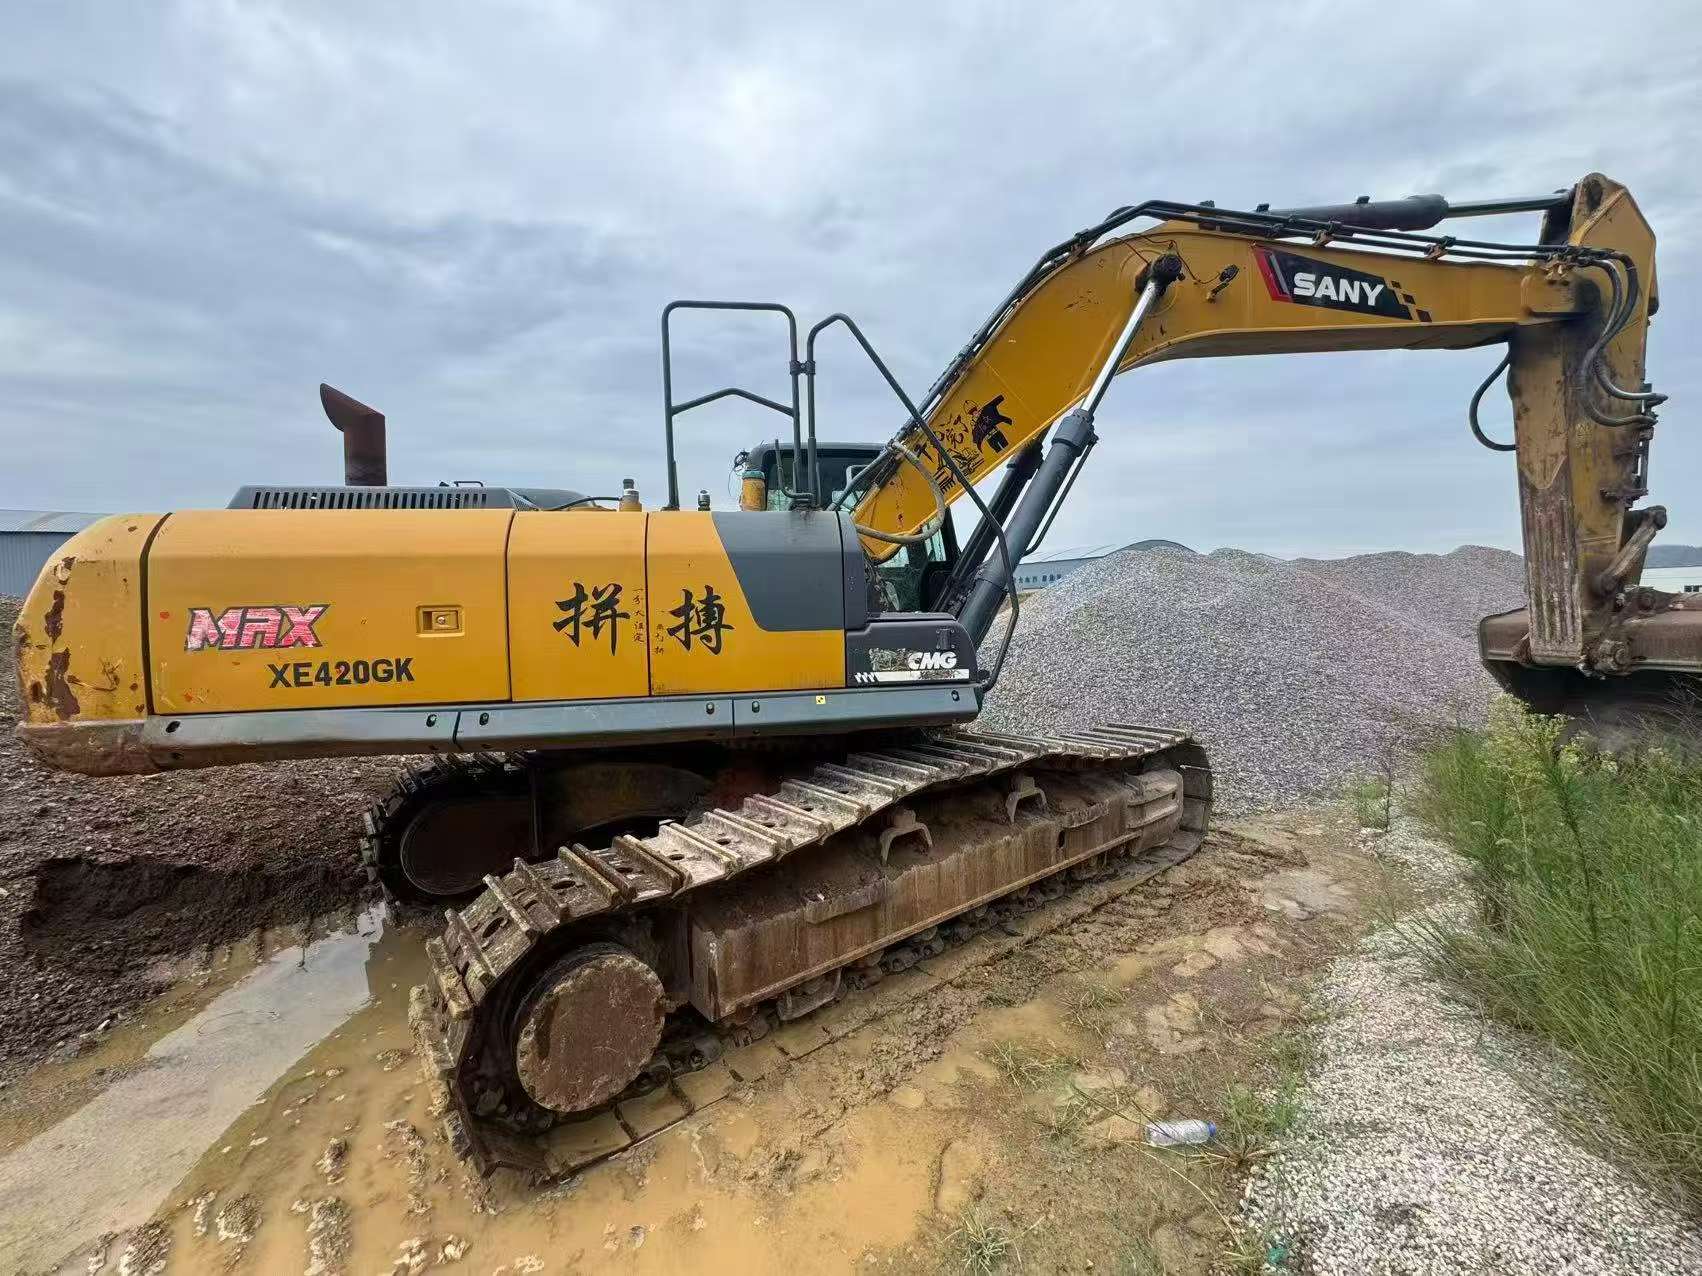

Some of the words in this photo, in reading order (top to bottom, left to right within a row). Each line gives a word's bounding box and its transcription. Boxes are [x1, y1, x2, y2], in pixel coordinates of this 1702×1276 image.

[1293, 272, 1384, 306] SANY
[184, 604, 331, 652] MAX
[553, 582, 735, 657] 拼搏
[267, 657, 415, 688] XE420GK
